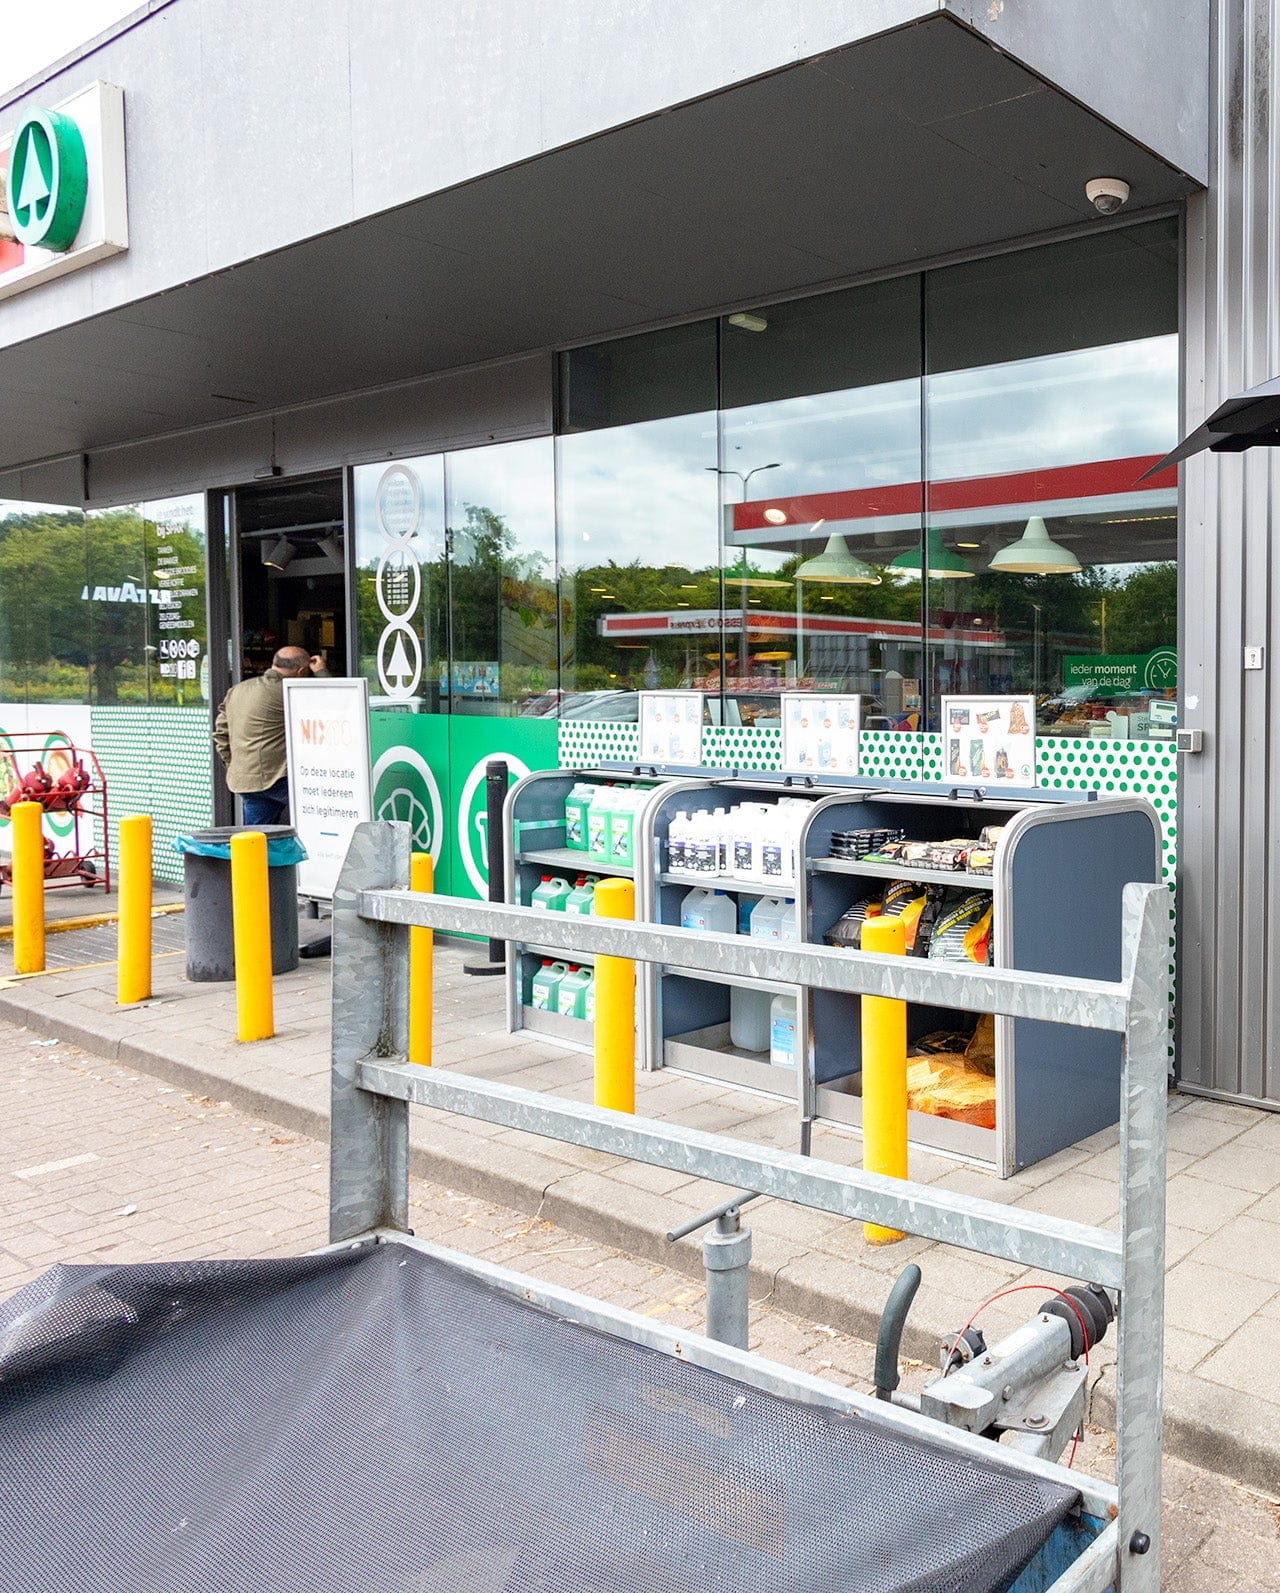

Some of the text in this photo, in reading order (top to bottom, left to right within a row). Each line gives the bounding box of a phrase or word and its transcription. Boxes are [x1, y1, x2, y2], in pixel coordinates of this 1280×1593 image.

[1070, 663, 1137, 674] ieder moment
[1082, 676, 1132, 688] van de dag
[300, 765, 355, 779] Op deze locatie
[302, 786, 354, 798] moet iedereen
[302, 804, 359, 819] zich legitimeren
